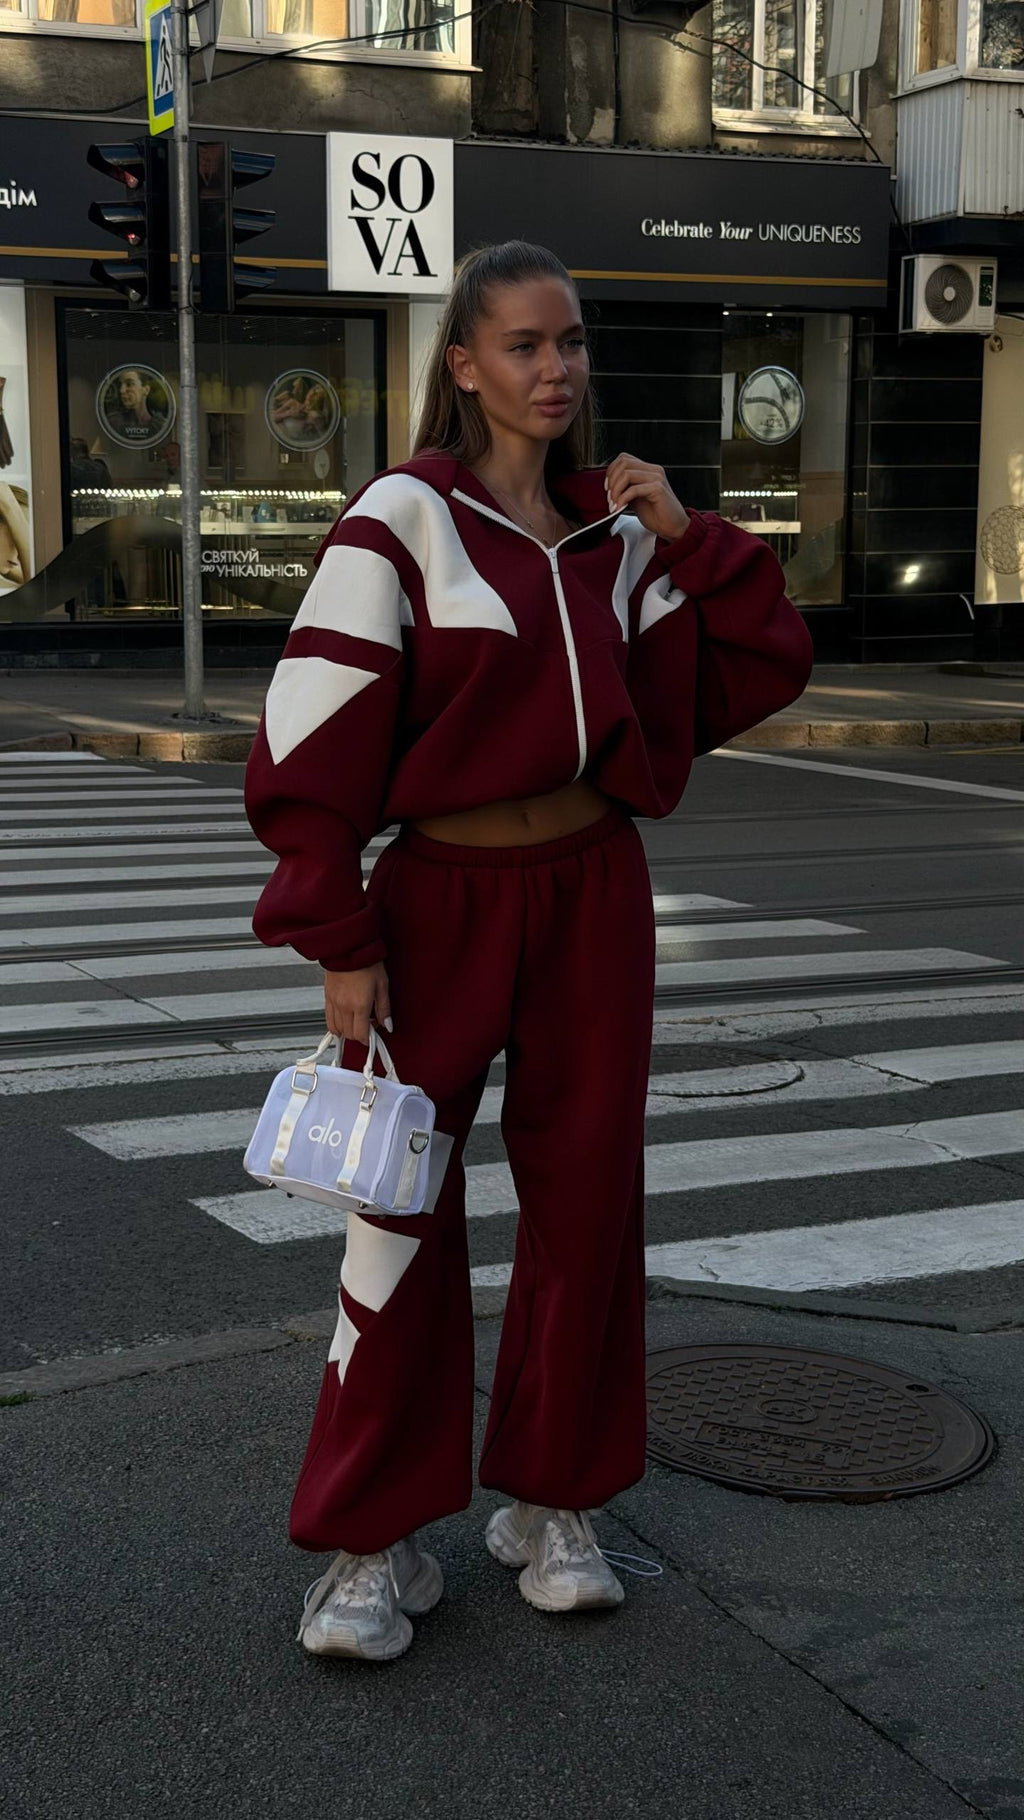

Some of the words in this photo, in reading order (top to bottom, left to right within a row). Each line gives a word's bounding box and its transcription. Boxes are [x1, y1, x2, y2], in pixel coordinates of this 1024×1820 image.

[350, 151, 435, 214] SO
[641, 218, 713, 240] Celebrate
[718, 221, 753, 241] Your
[758, 223, 862, 245] UNIQUENESS
[347, 216, 438, 278] VA
[201, 548, 260, 564] СВЯТКУЙ
[216, 563, 309, 578] УНІКАЛЬНІСТЬ
[308, 1117, 342, 1148] alo
